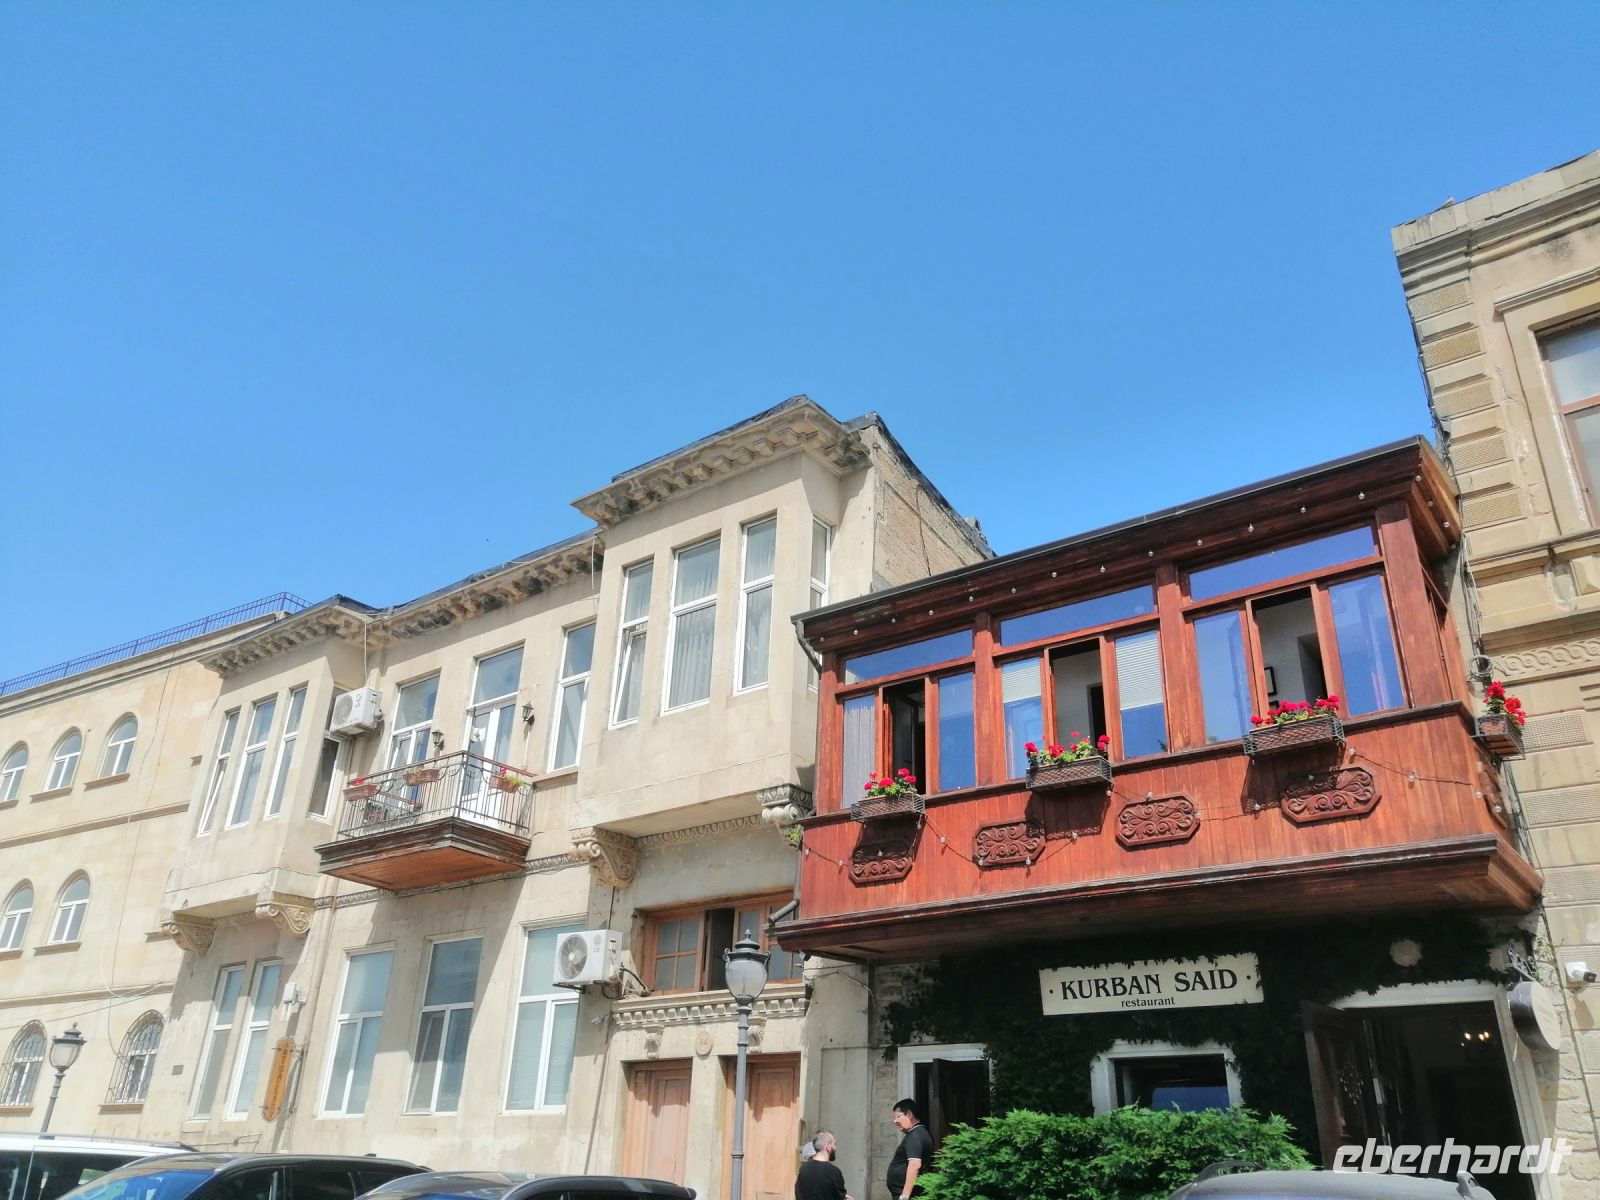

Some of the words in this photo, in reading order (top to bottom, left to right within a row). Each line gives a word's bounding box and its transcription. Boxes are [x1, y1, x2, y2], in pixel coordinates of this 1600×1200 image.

[1060, 974, 1162, 1000] KURBAN
[1174, 969, 1238, 992] SAID
[1121, 997, 1175, 1008] restaurant
